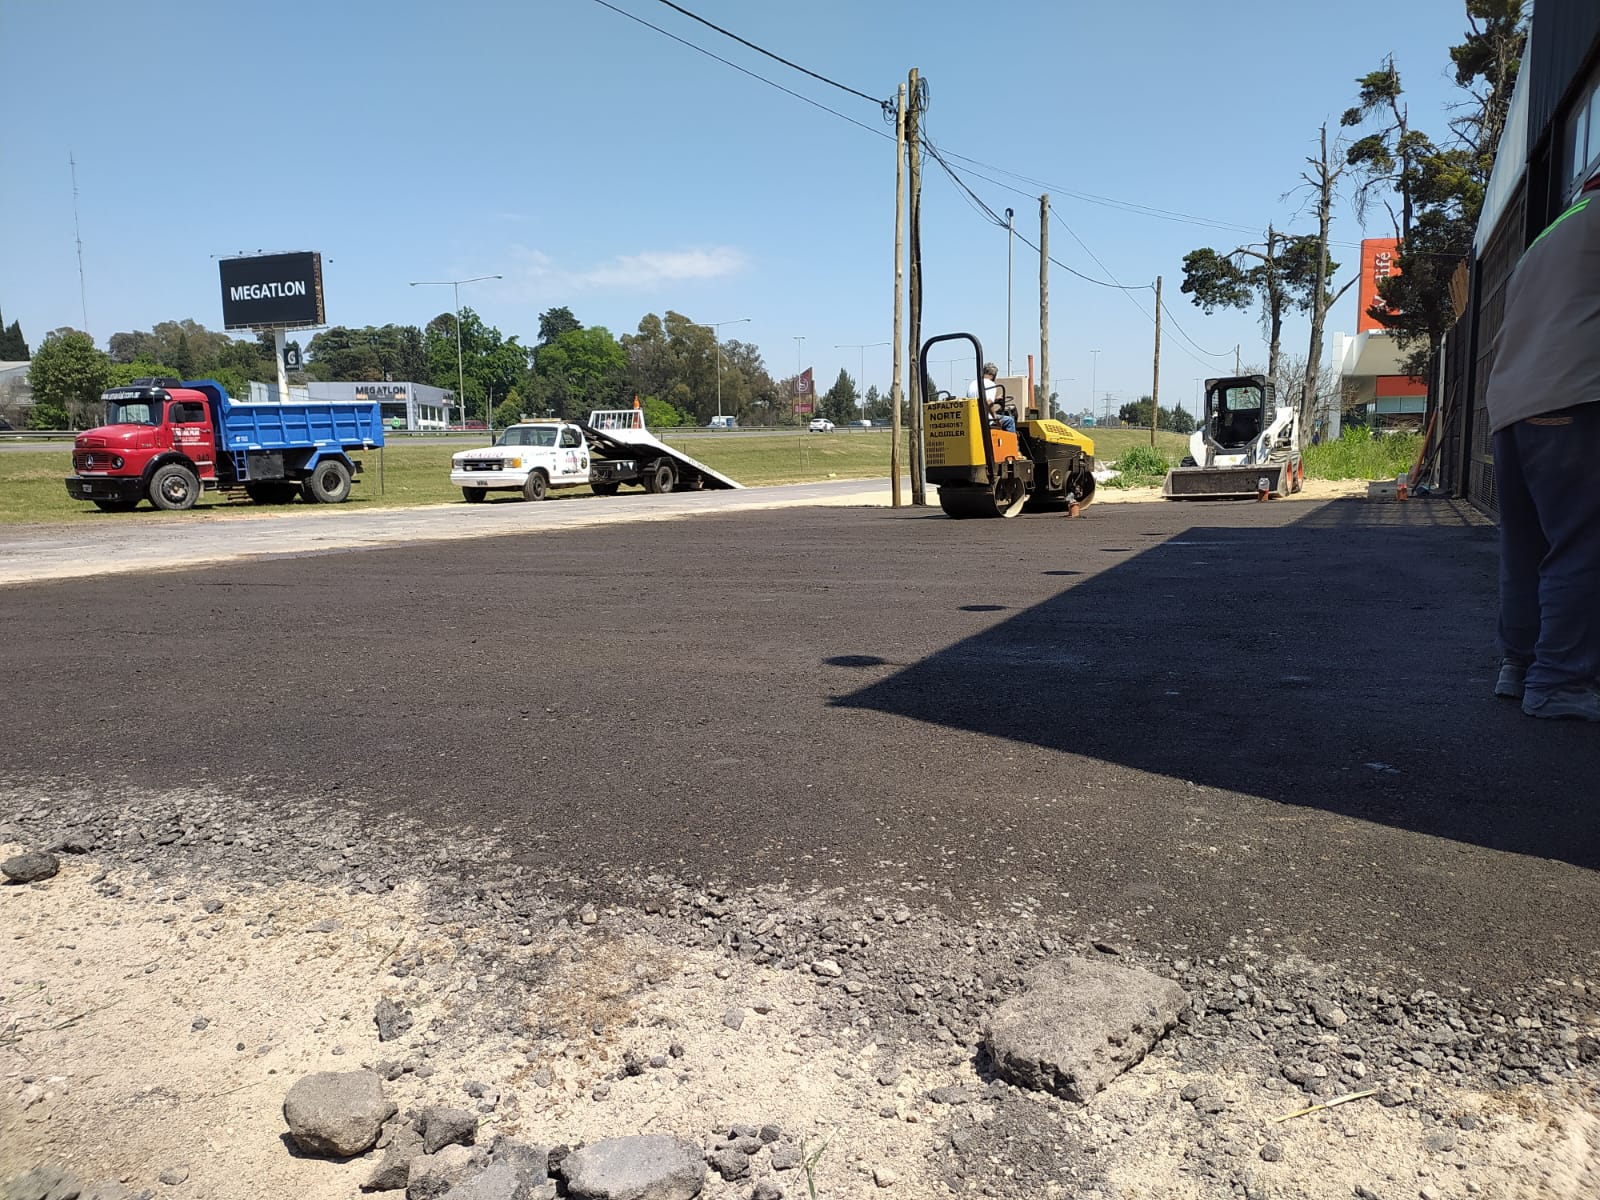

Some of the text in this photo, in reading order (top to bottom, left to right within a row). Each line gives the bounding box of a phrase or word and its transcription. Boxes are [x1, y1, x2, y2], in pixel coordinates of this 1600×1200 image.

[230, 281, 306, 301] MEGATLON
[355, 386, 406, 394] MEGATLON
[927, 402, 964, 411] ASFALTOS
[929, 411, 962, 421] NORTE
[929, 430, 965, 438] ALQUILER
